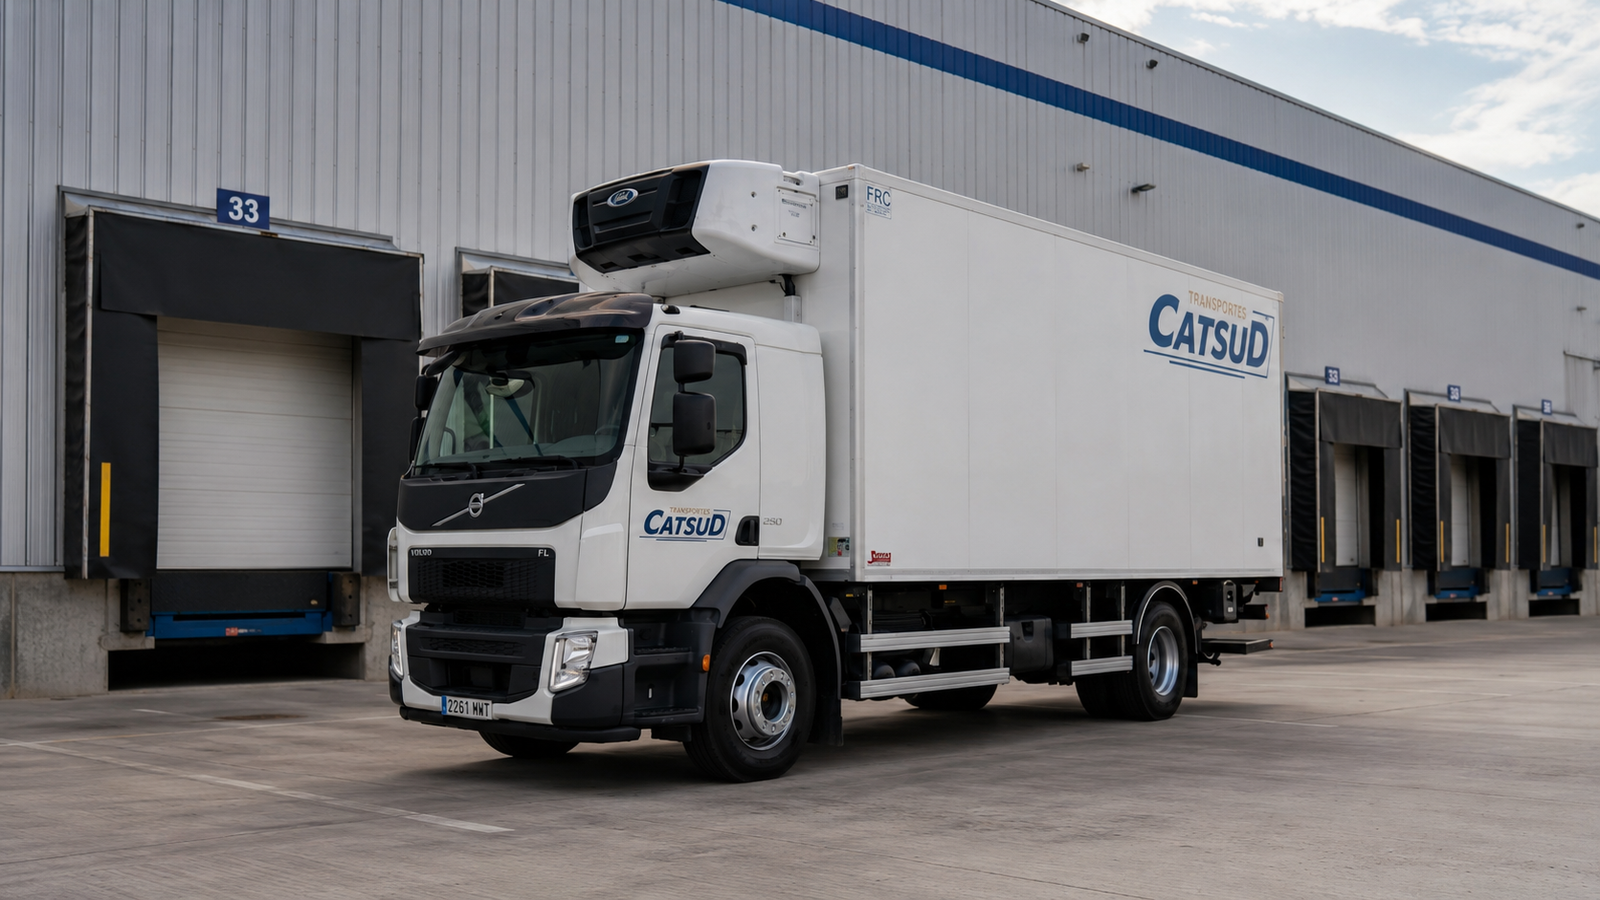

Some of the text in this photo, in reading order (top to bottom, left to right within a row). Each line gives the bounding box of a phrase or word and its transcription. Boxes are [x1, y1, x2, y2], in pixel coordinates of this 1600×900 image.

[866, 185, 891, 207] FRC
[228, 195, 259, 224] 33
[1188, 290, 1247, 320] TRANSPORTES
[1148, 293, 1269, 368] CATSUD
[643, 509, 726, 536] CATSUD
[669, 506, 710, 515] TRANSPORTES
[537, 549, 549, 557] FL
[447, 699, 469, 715] 2261
